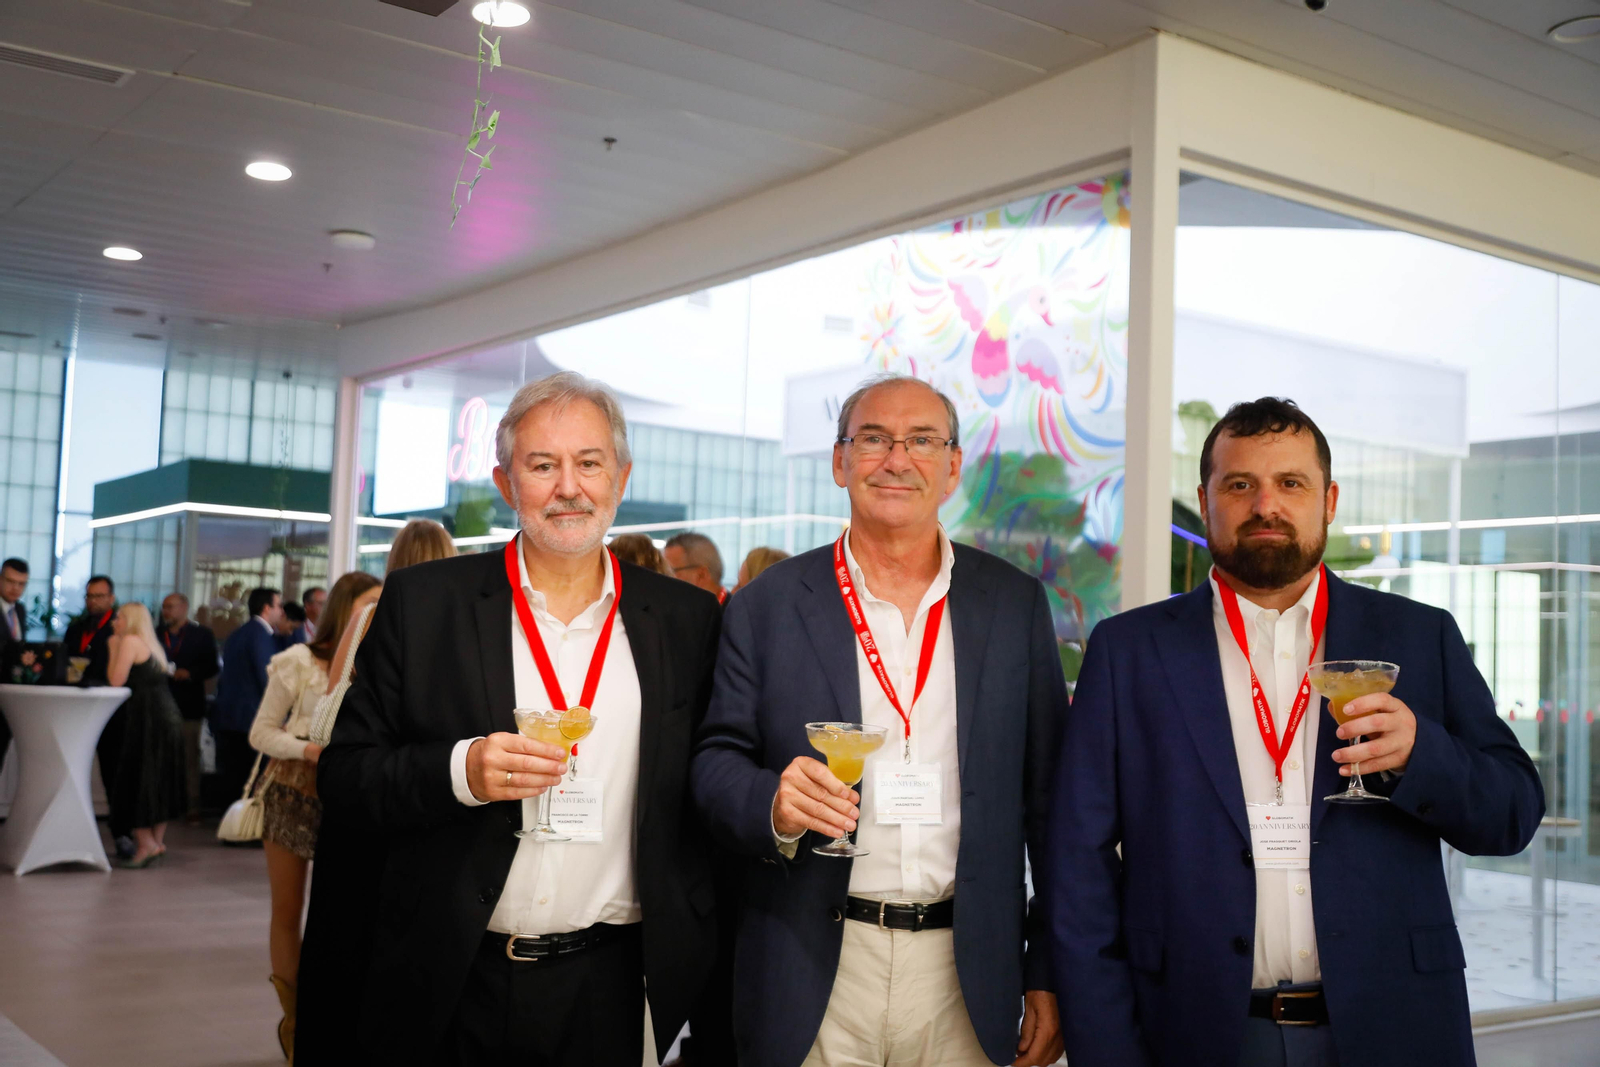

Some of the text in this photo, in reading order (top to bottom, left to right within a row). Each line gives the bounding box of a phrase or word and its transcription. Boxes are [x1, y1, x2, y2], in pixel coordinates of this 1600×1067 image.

[848, 595, 862, 625] GLOBOMATIK
[877, 664, 895, 699] GLOBOMATIK
[1257, 698, 1271, 734] GLOBOMATIK
[1289, 697, 1306, 733] GLOBOMATIK
